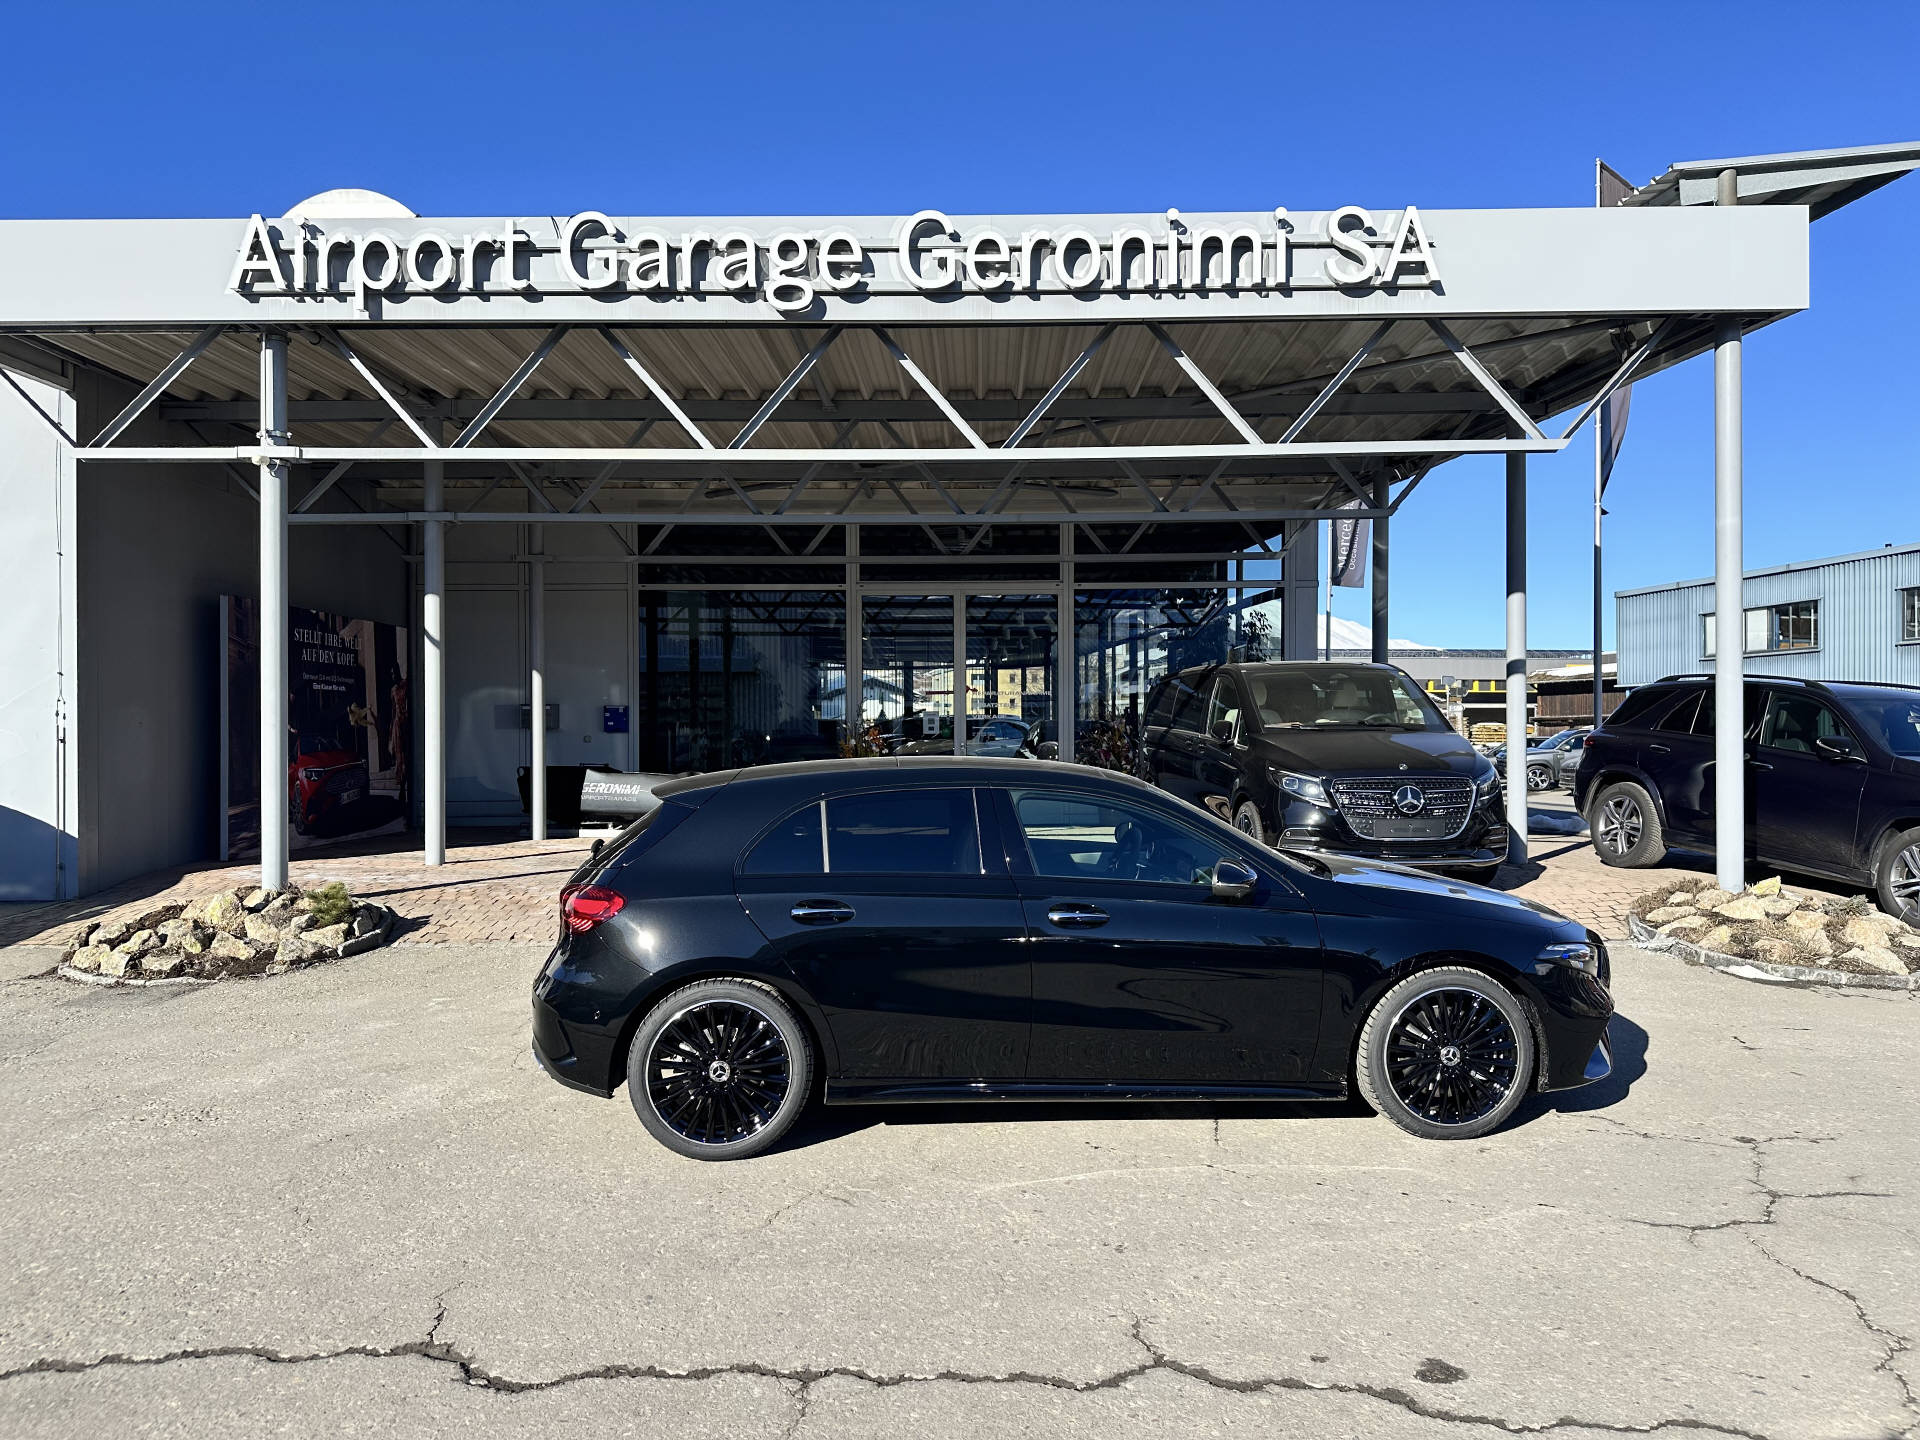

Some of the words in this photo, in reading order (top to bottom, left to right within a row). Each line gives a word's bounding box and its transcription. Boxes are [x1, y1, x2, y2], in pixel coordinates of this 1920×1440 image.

[225, 212, 531, 312] Airport
[560, 210, 864, 311] Garage
[899, 206, 1291, 290] Geronimi
[1325, 204, 1441, 284] SA
[294, 628, 322, 644] STELLT
[324, 633, 342, 648] IHRE
[301, 648, 317, 662] AUF
[319, 650, 334, 663] DEN
